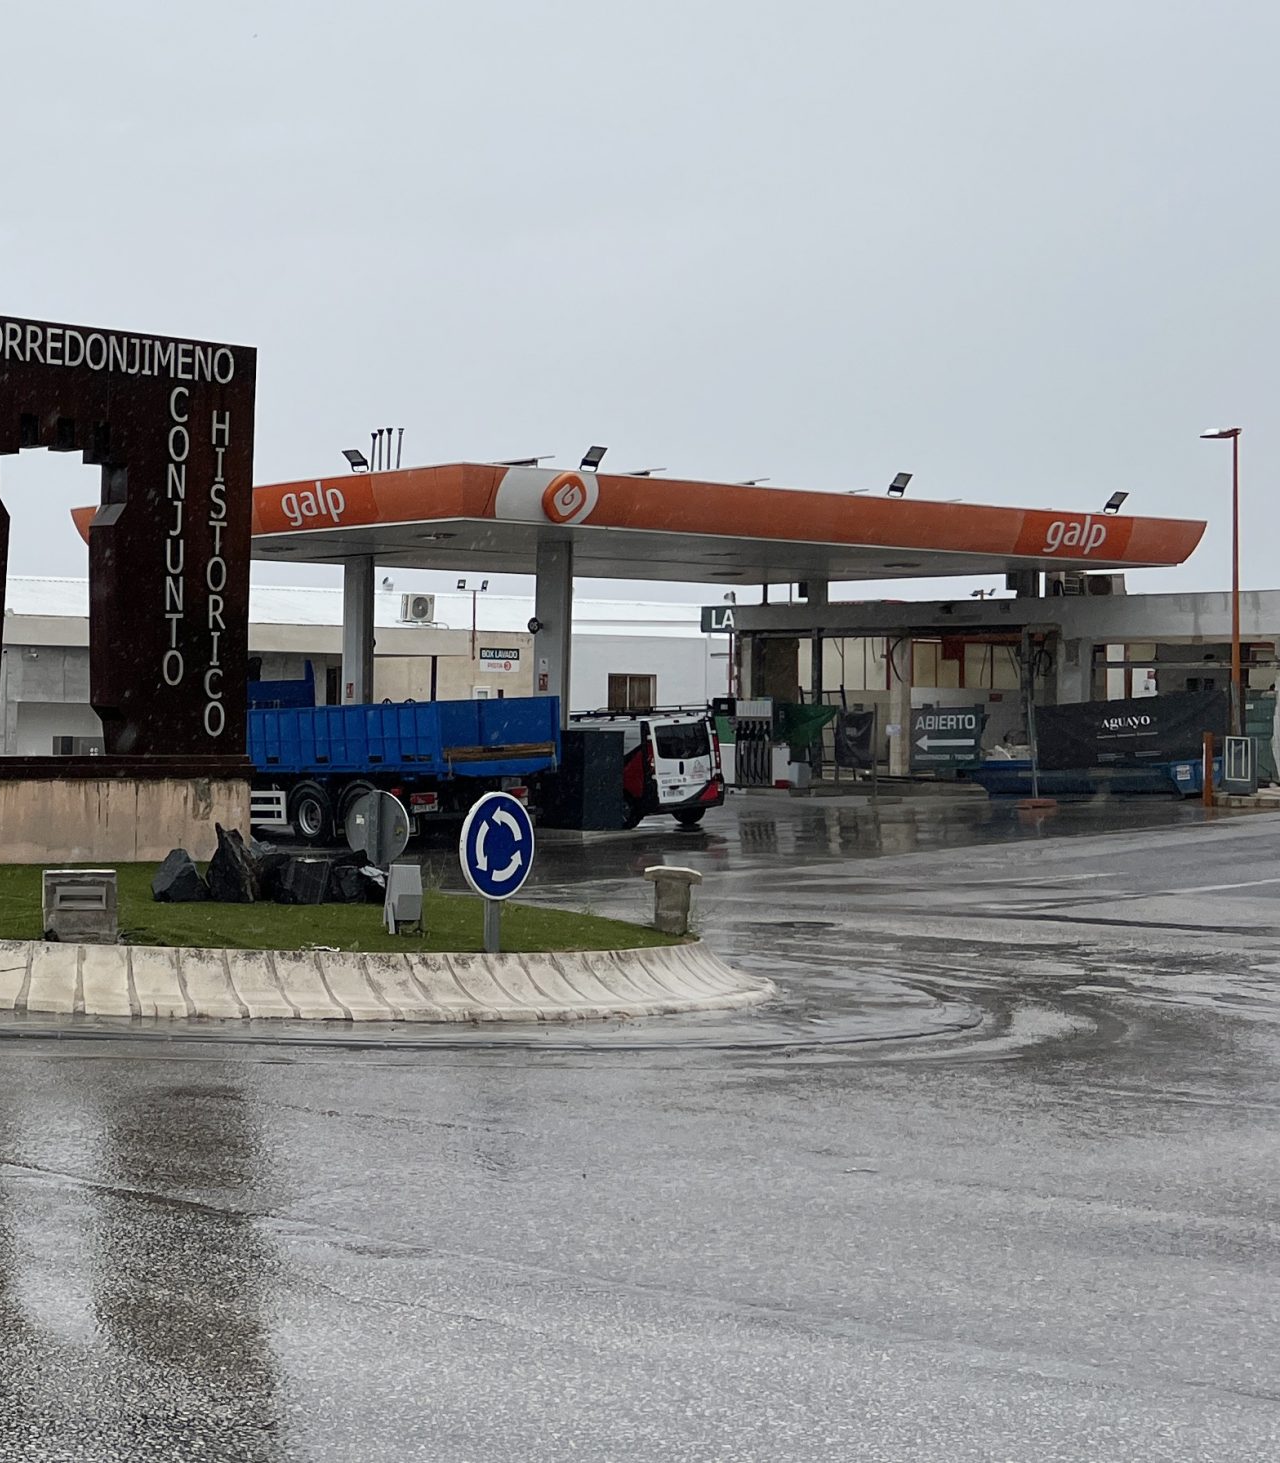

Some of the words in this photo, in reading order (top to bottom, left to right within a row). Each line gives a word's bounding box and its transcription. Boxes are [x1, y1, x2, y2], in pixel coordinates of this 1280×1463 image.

[281, 480, 346, 527] galp
[162, 386, 190, 686] CONJUNTO
[1042, 514, 1107, 555] galp
[203, 410, 231, 737] HISTORICO
[481, 649, 495, 658] BOX
[495, 651, 518, 659] LAVADO
[915, 714, 976, 730] ABIERTO
